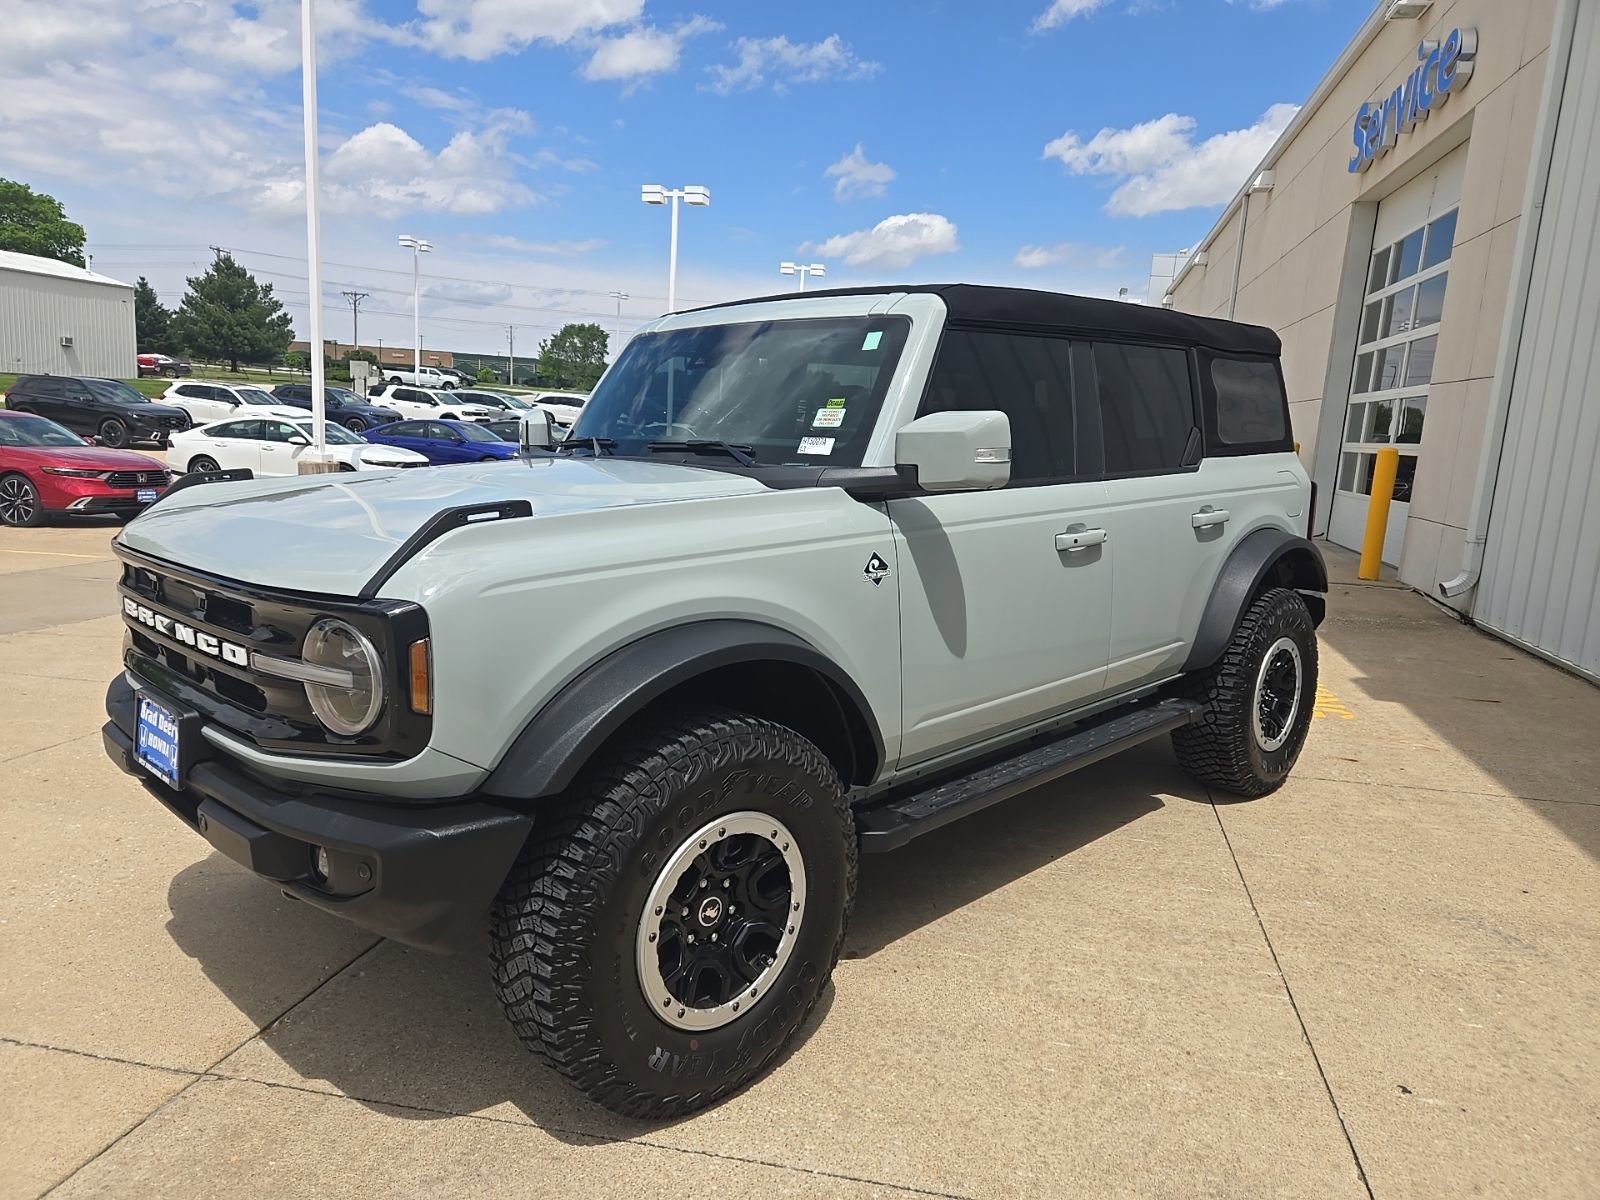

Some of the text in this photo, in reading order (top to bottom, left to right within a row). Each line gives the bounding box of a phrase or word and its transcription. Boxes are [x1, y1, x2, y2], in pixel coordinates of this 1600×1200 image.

[1347, 27, 1472, 174] Service
[123, 597, 249, 667] BRONCO
[140, 699, 158, 727] Brad
[158, 713, 179, 744] Deery
[147, 732, 170, 758] HONDA
